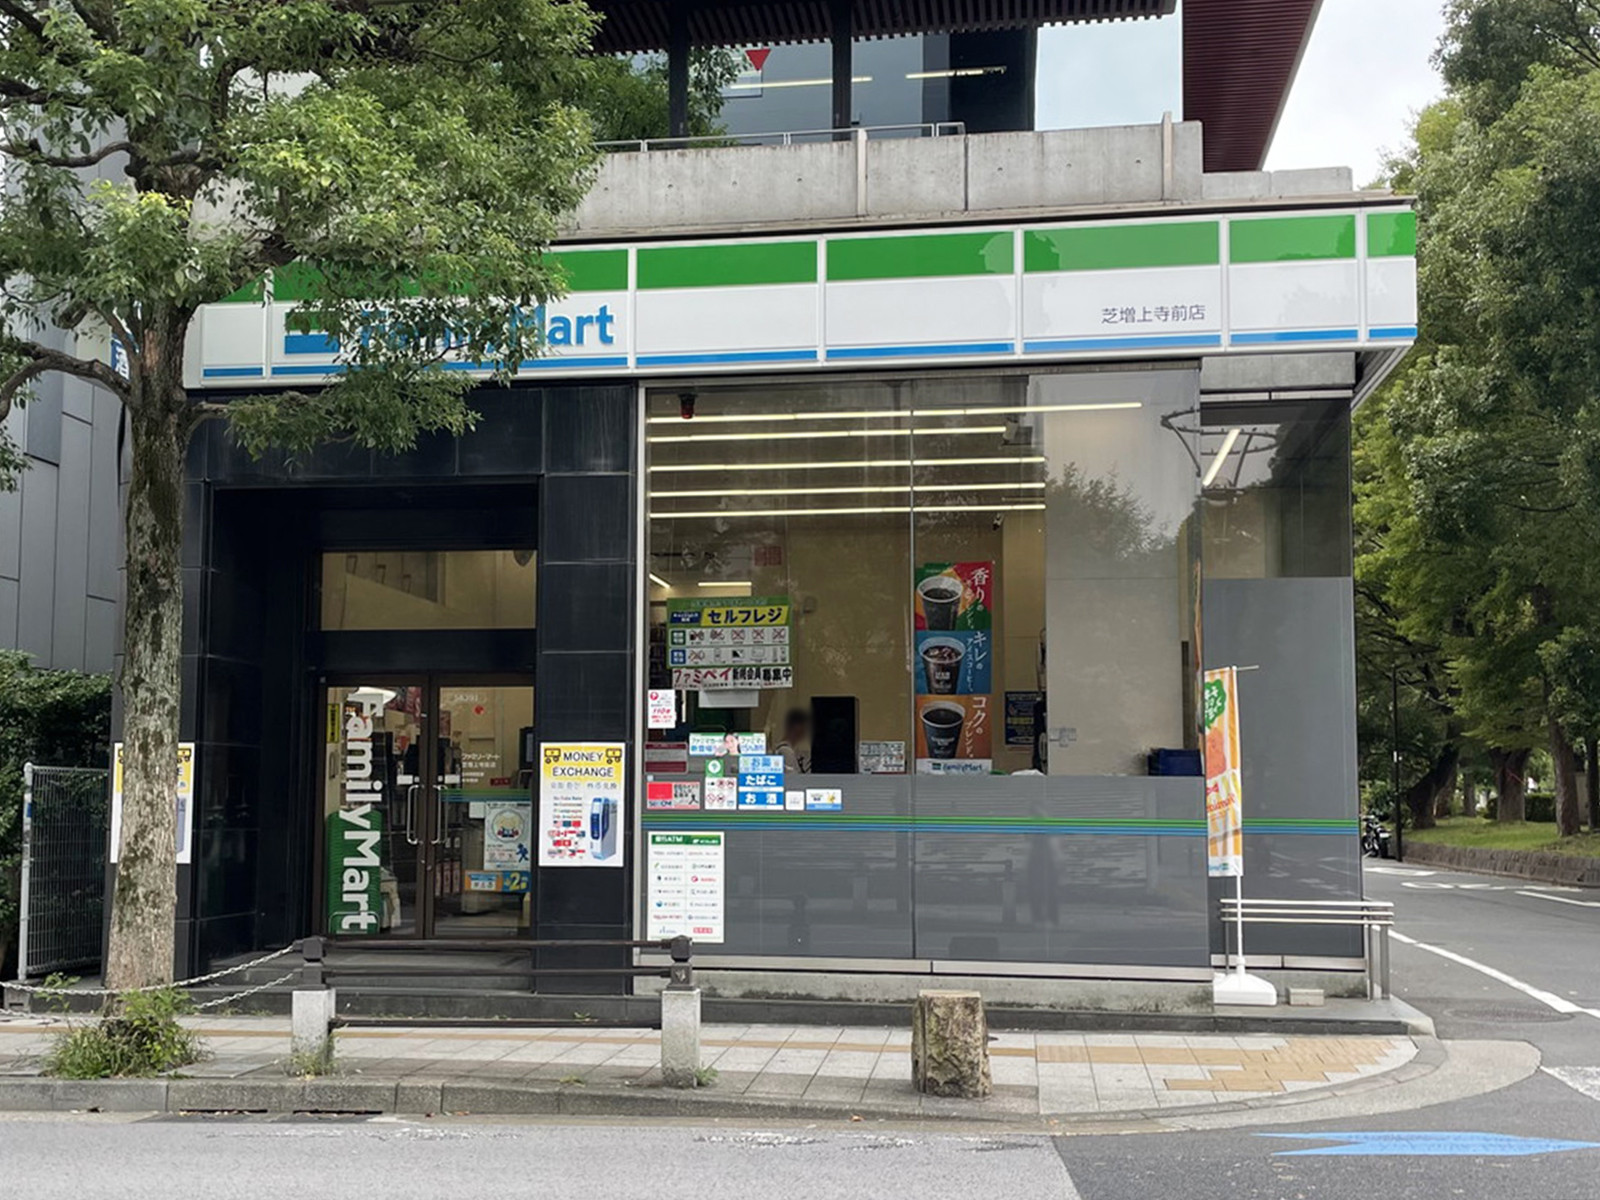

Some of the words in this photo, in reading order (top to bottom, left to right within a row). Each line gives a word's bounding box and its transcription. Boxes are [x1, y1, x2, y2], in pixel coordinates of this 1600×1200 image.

[1100, 305, 1206, 324] 芝増上寺前店
[708, 608, 782, 624] セルフレジ
[563, 751, 604, 762] MONEY
[552, 766, 614, 777] EXCHANGE
[745, 775, 777, 786] たばこ
[339, 693, 384, 930] FamilyMart
